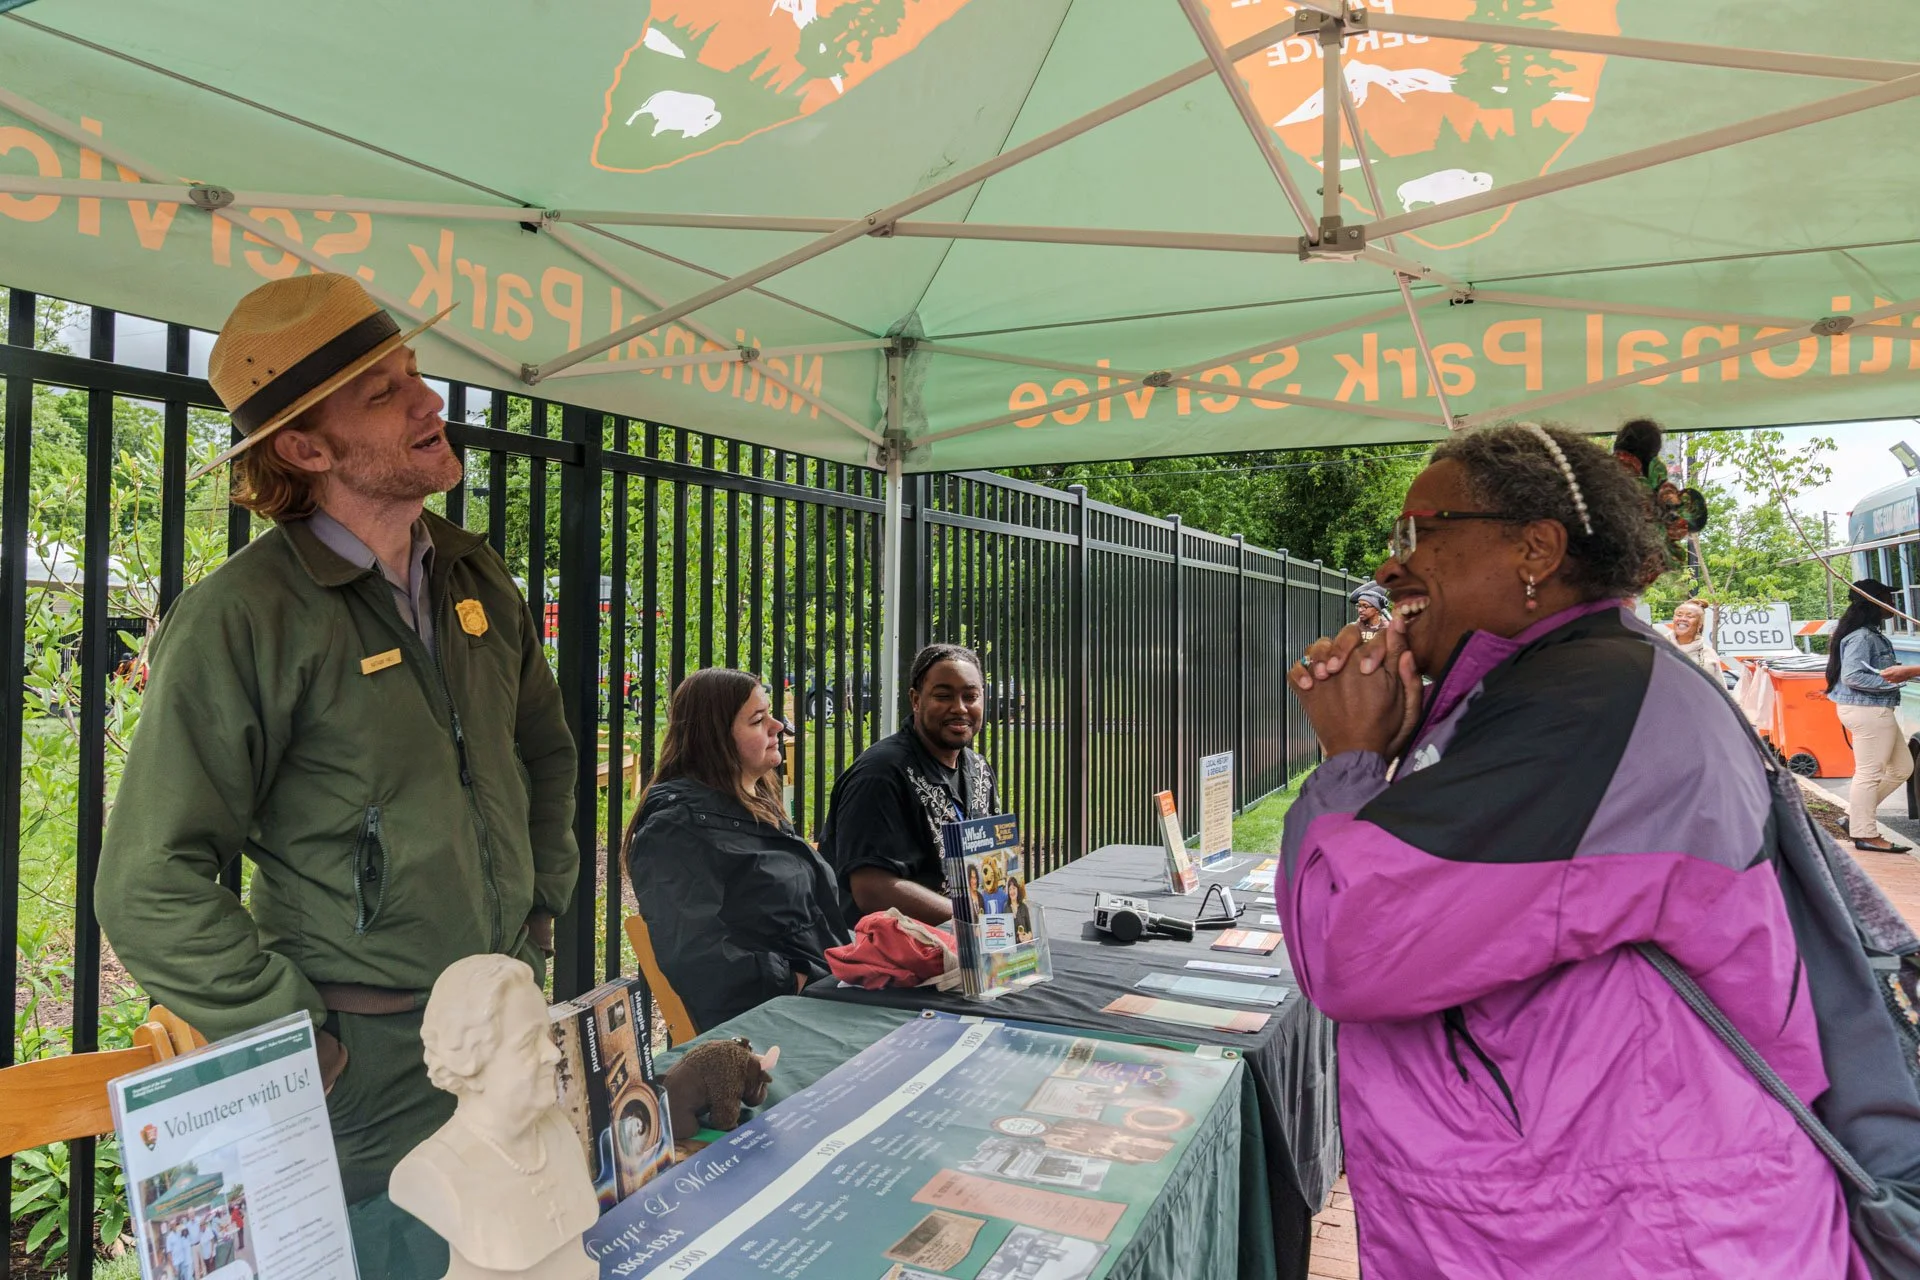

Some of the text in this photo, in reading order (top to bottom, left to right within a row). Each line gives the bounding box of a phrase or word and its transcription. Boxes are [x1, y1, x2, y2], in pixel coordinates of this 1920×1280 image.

[1719, 609, 1770, 625] ROAD
[962, 837, 994, 852] Happening
[964, 825, 987, 841] What's
[634, 990, 645, 1033] Maggie
[585, 1016, 601, 1074] Richmond
[640, 1032, 648, 1042] L.
[961, 1031, 984, 1049] 1930
[642, 1042, 654, 1081] Walker
[164, 1093, 245, 1139] Volunteer
[247, 1083, 281, 1107] with
[284, 1068, 311, 1094] Us!
[817, 1139, 846, 1157] 1910
[674, 1153, 741, 1194] Walker
[611, 1227, 685, 1277] 1864-1934
[669, 1249, 708, 1273] 1900
